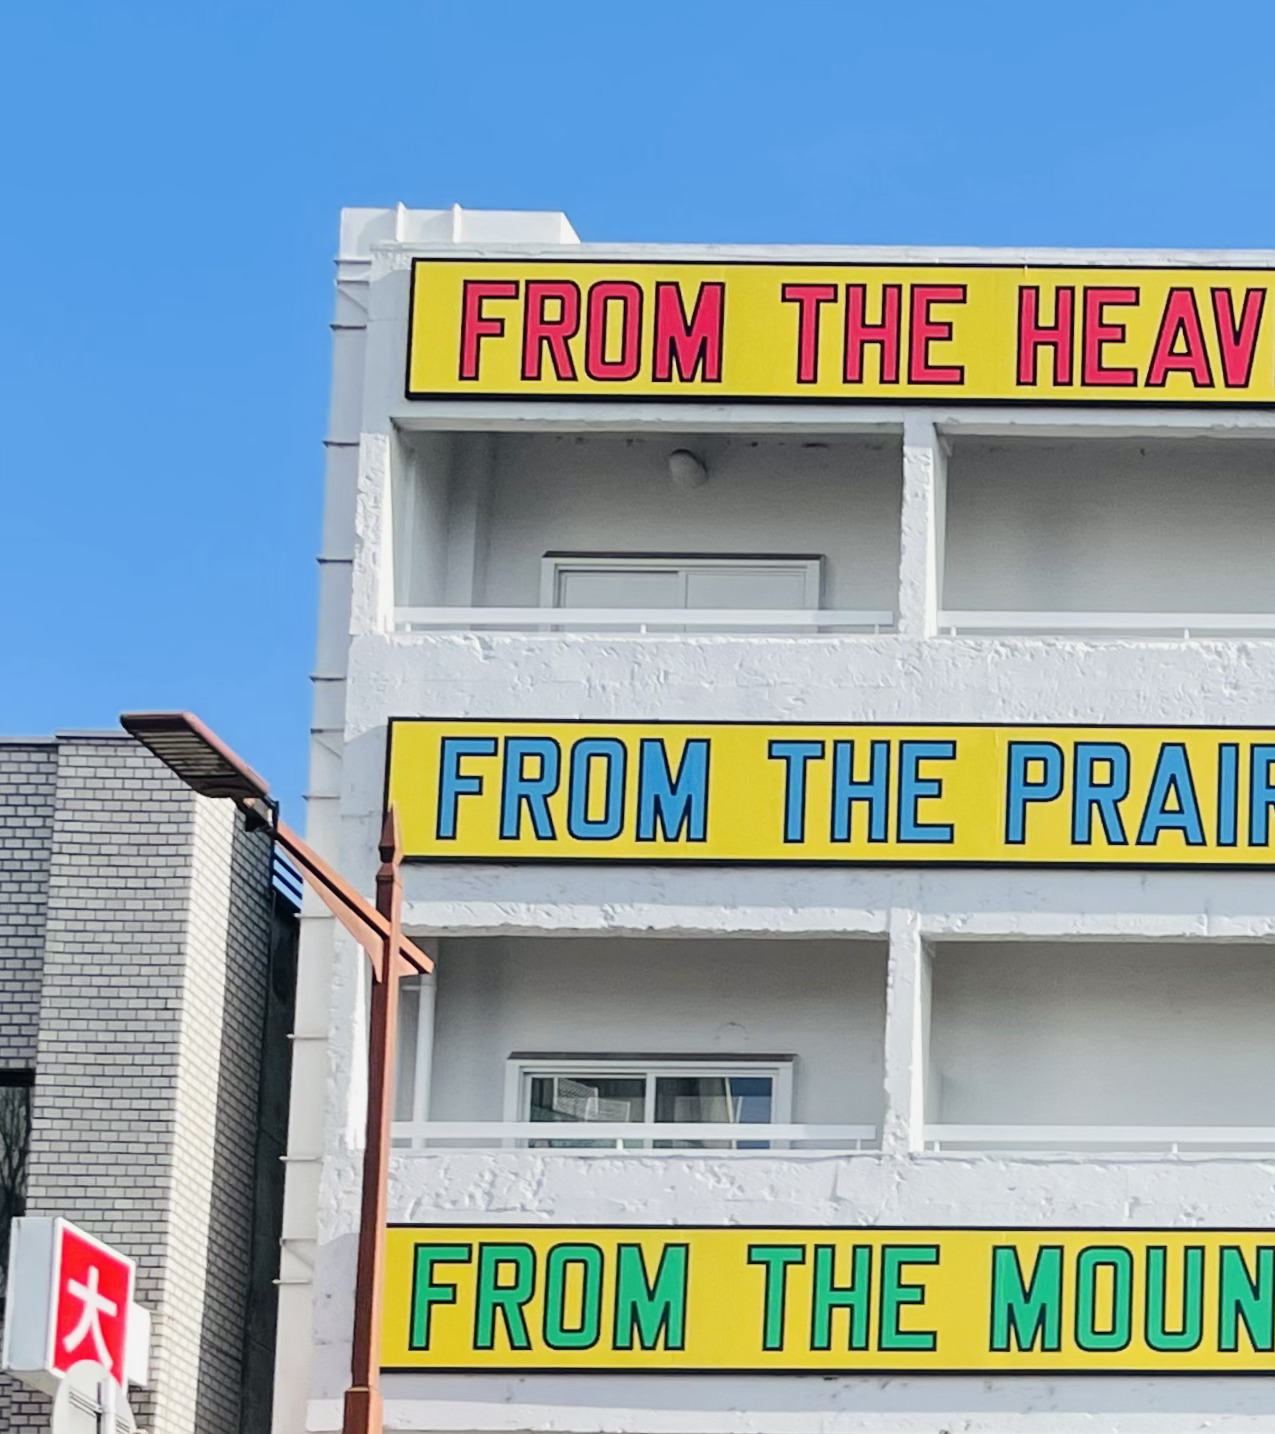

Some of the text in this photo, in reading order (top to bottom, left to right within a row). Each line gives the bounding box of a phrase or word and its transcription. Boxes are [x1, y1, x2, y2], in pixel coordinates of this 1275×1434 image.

[458, 280, 727, 385] FROM
[778, 281, 968, 387] THE
[434, 733, 711, 844] FROM
[765, 737, 958, 847] THE
[407, 1240, 689, 1353] FROM
[746, 1242, 940, 1353] THE
